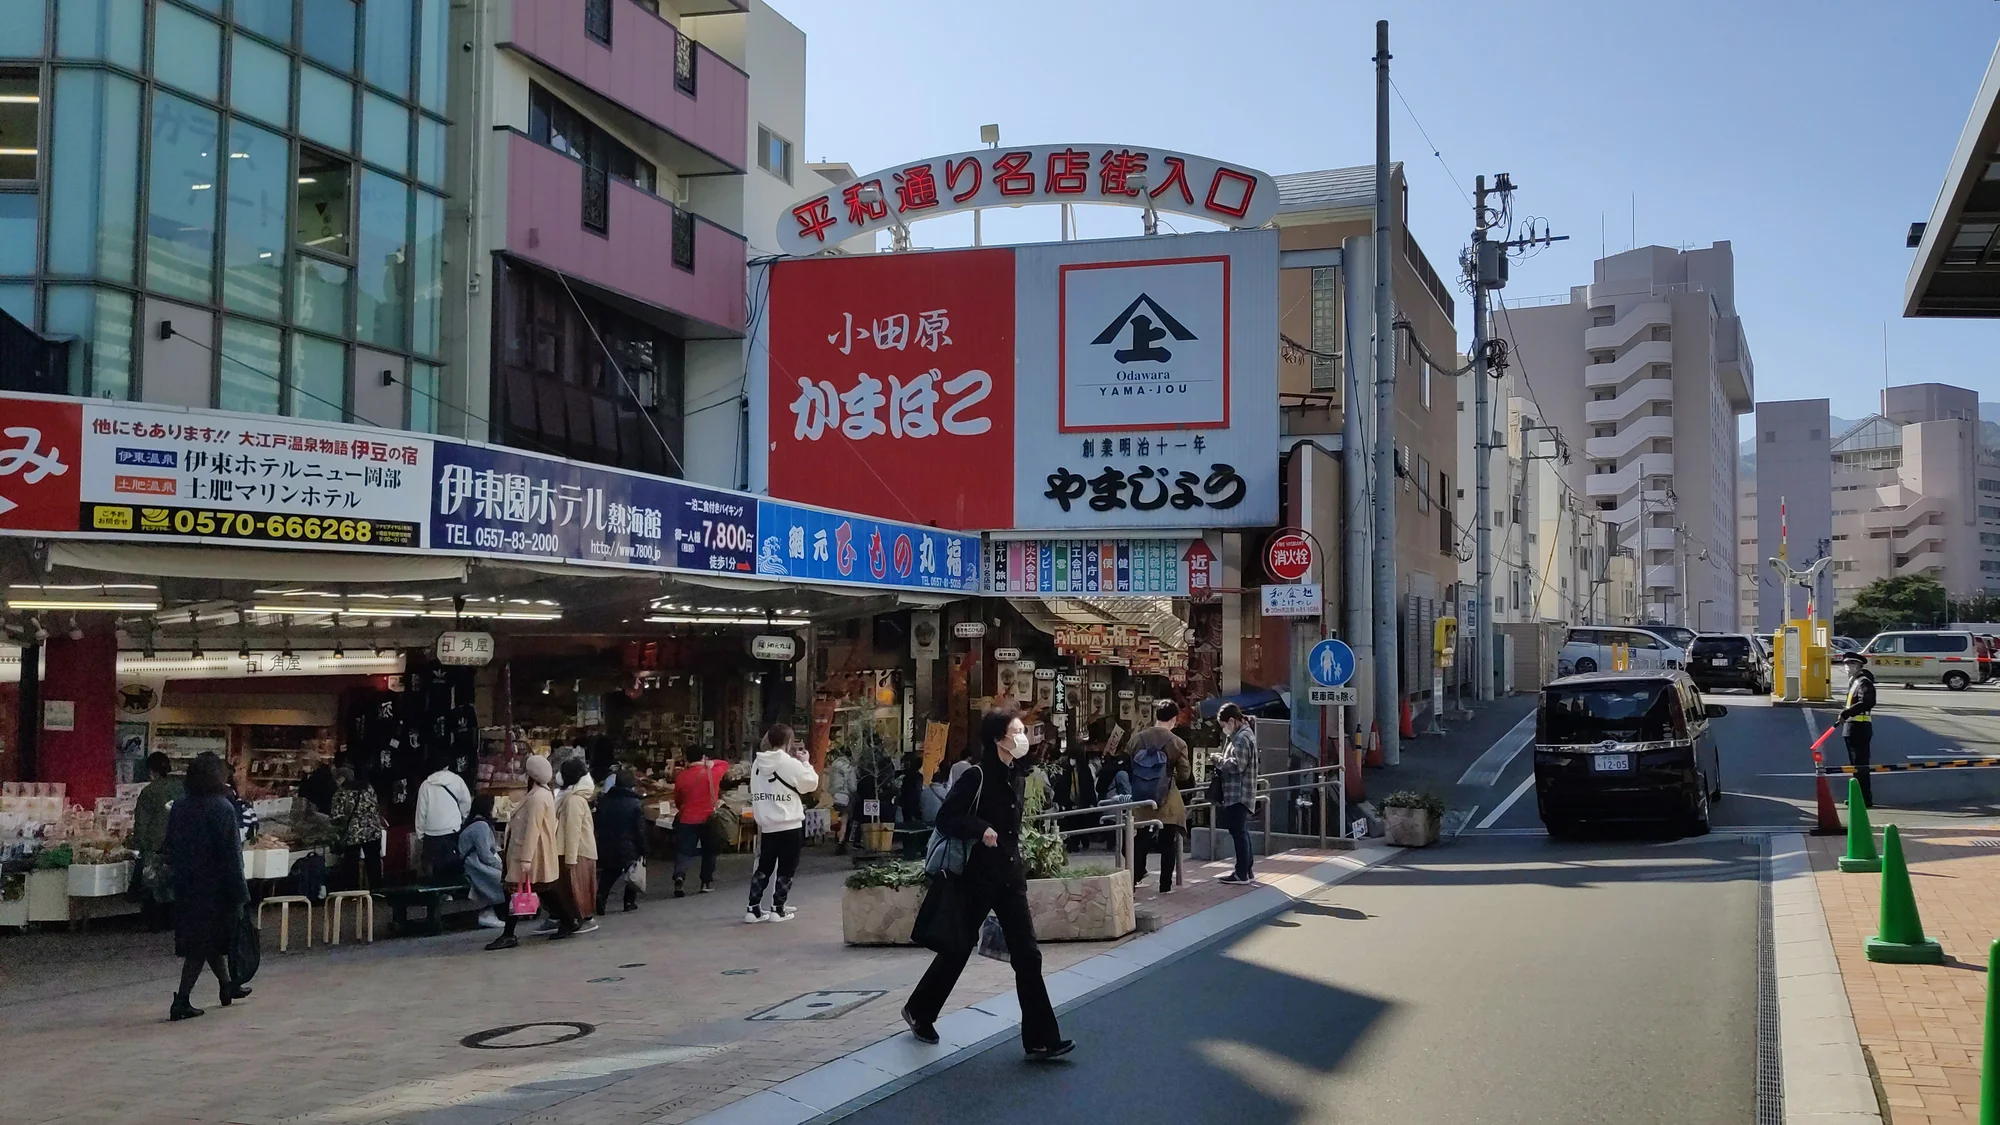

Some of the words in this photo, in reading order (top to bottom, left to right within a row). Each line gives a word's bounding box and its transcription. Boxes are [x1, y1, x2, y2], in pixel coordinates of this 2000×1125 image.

[793, 148, 1257, 242] 平和通り名店街入口
[828, 309, 953, 355] 小田原
[1116, 371, 1171, 382] Odawara
[1099, 384, 1188, 397] YAMA-JOU
[789, 368, 993, 441] かまぼこ
[92, 418, 230, 444] 他にもあります!!
[238, 431, 348, 456] 大江戸温泉物語
[351, 438, 419, 466] 伊豆の宿
[1082, 434, 1207, 458] 創業明治十一年
[0, 427, 69, 484] み
[118, 450, 175, 466] 伊東温泉
[184, 449, 402, 490] 伊東ホテルニュー岡部
[116, 479, 175, 493] 土肥温泉
[184, 477, 362, 510] 土肥マリンホテル
[1043, 463, 1247, 512] やまじょう
[102, 510, 125, 518] ご予約
[685, 498, 744, 518] 一泊二食付きバイキング
[174, 509, 372, 542] 0570-666268
[446, 523, 472, 546] TEL
[475, 527, 559, 552] 0557-83-2000
[709, 554, 737, 571] 徒歩1分
[1273, 548, 1309, 567] 消火栓
[1190, 554, 1208, 588] 近道
[461, 637, 489, 653] 角屋
[269, 654, 302, 672] 角屋
[1311, 691, 1354, 702] 軽車両を除く
[1603, 760, 1627, 769] 12-05
